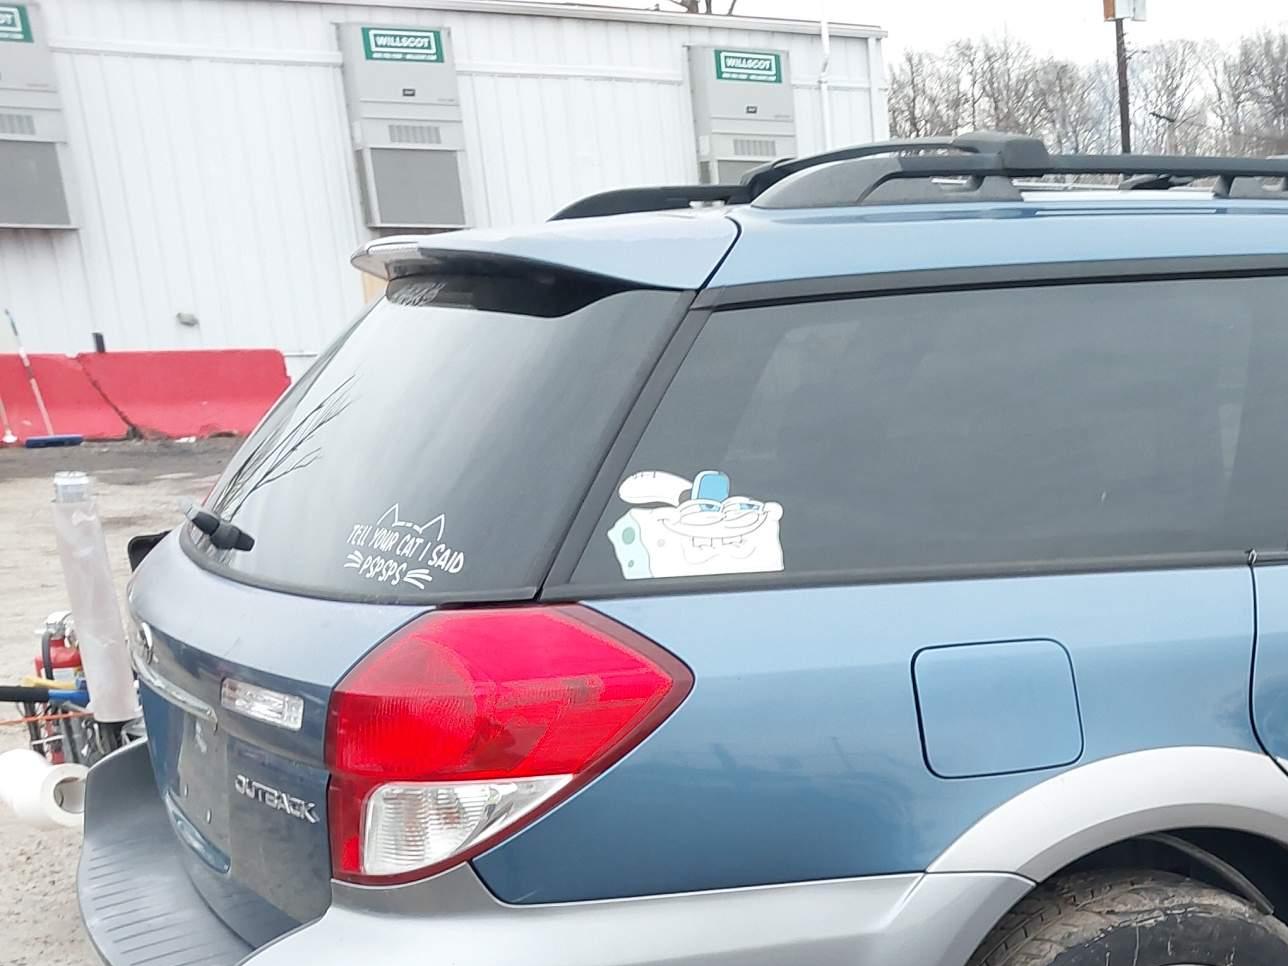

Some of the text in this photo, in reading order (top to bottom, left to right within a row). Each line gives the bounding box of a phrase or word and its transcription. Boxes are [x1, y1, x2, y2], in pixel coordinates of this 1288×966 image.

[375, 35, 430, 48] WILLSCOT
[725, 57, 771, 70] WILLSCOT
[346, 524, 464, 574] TELL YOUR CAT I SAID
[359, 555, 408, 585] PSPSPS
[234, 774, 320, 823] OUTBACK
